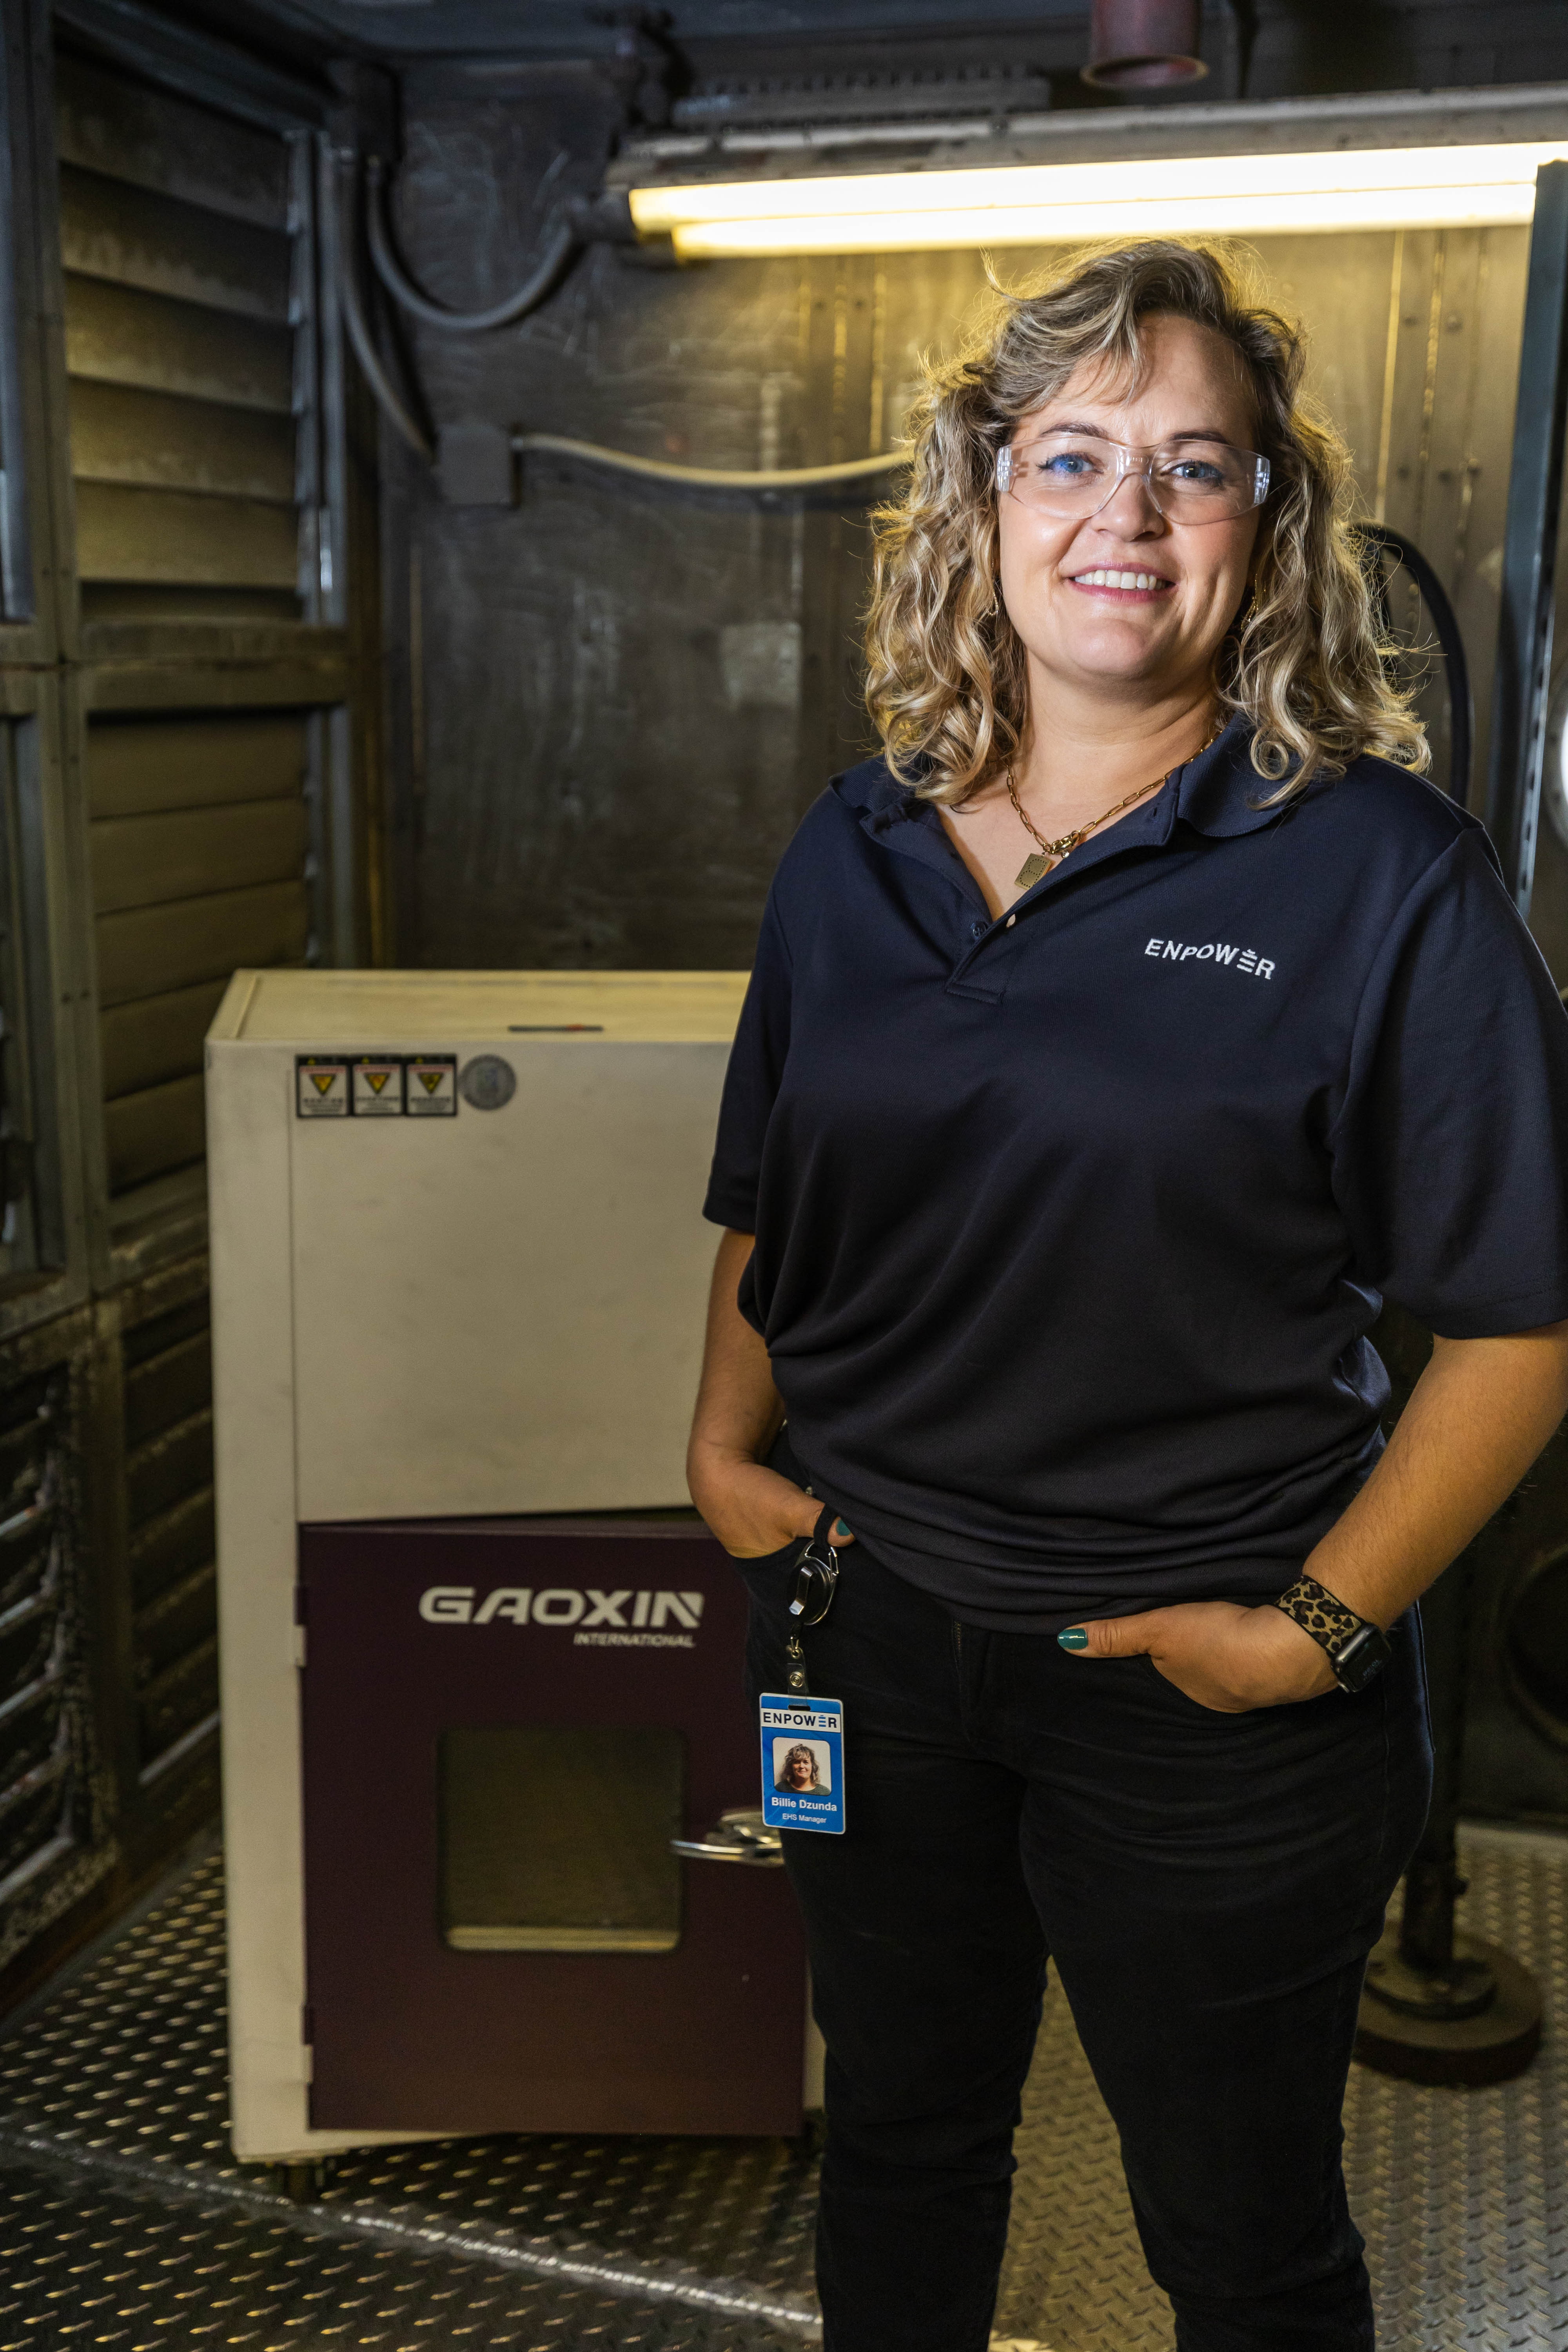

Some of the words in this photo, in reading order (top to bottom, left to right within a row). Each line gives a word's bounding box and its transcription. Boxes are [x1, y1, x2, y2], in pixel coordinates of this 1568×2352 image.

[1145, 938, 1276, 980] ENPOWER
[419, 1586, 704, 1628] GAOXIN
[573, 1632, 695, 1648] INTERNATIONAL
[763, 1712, 837, 1728] ENPOWER
[771, 1797, 797, 1808] Billie
[799, 1799, 837, 1811] Dzunda
[799, 1815, 827, 1824] Manager
